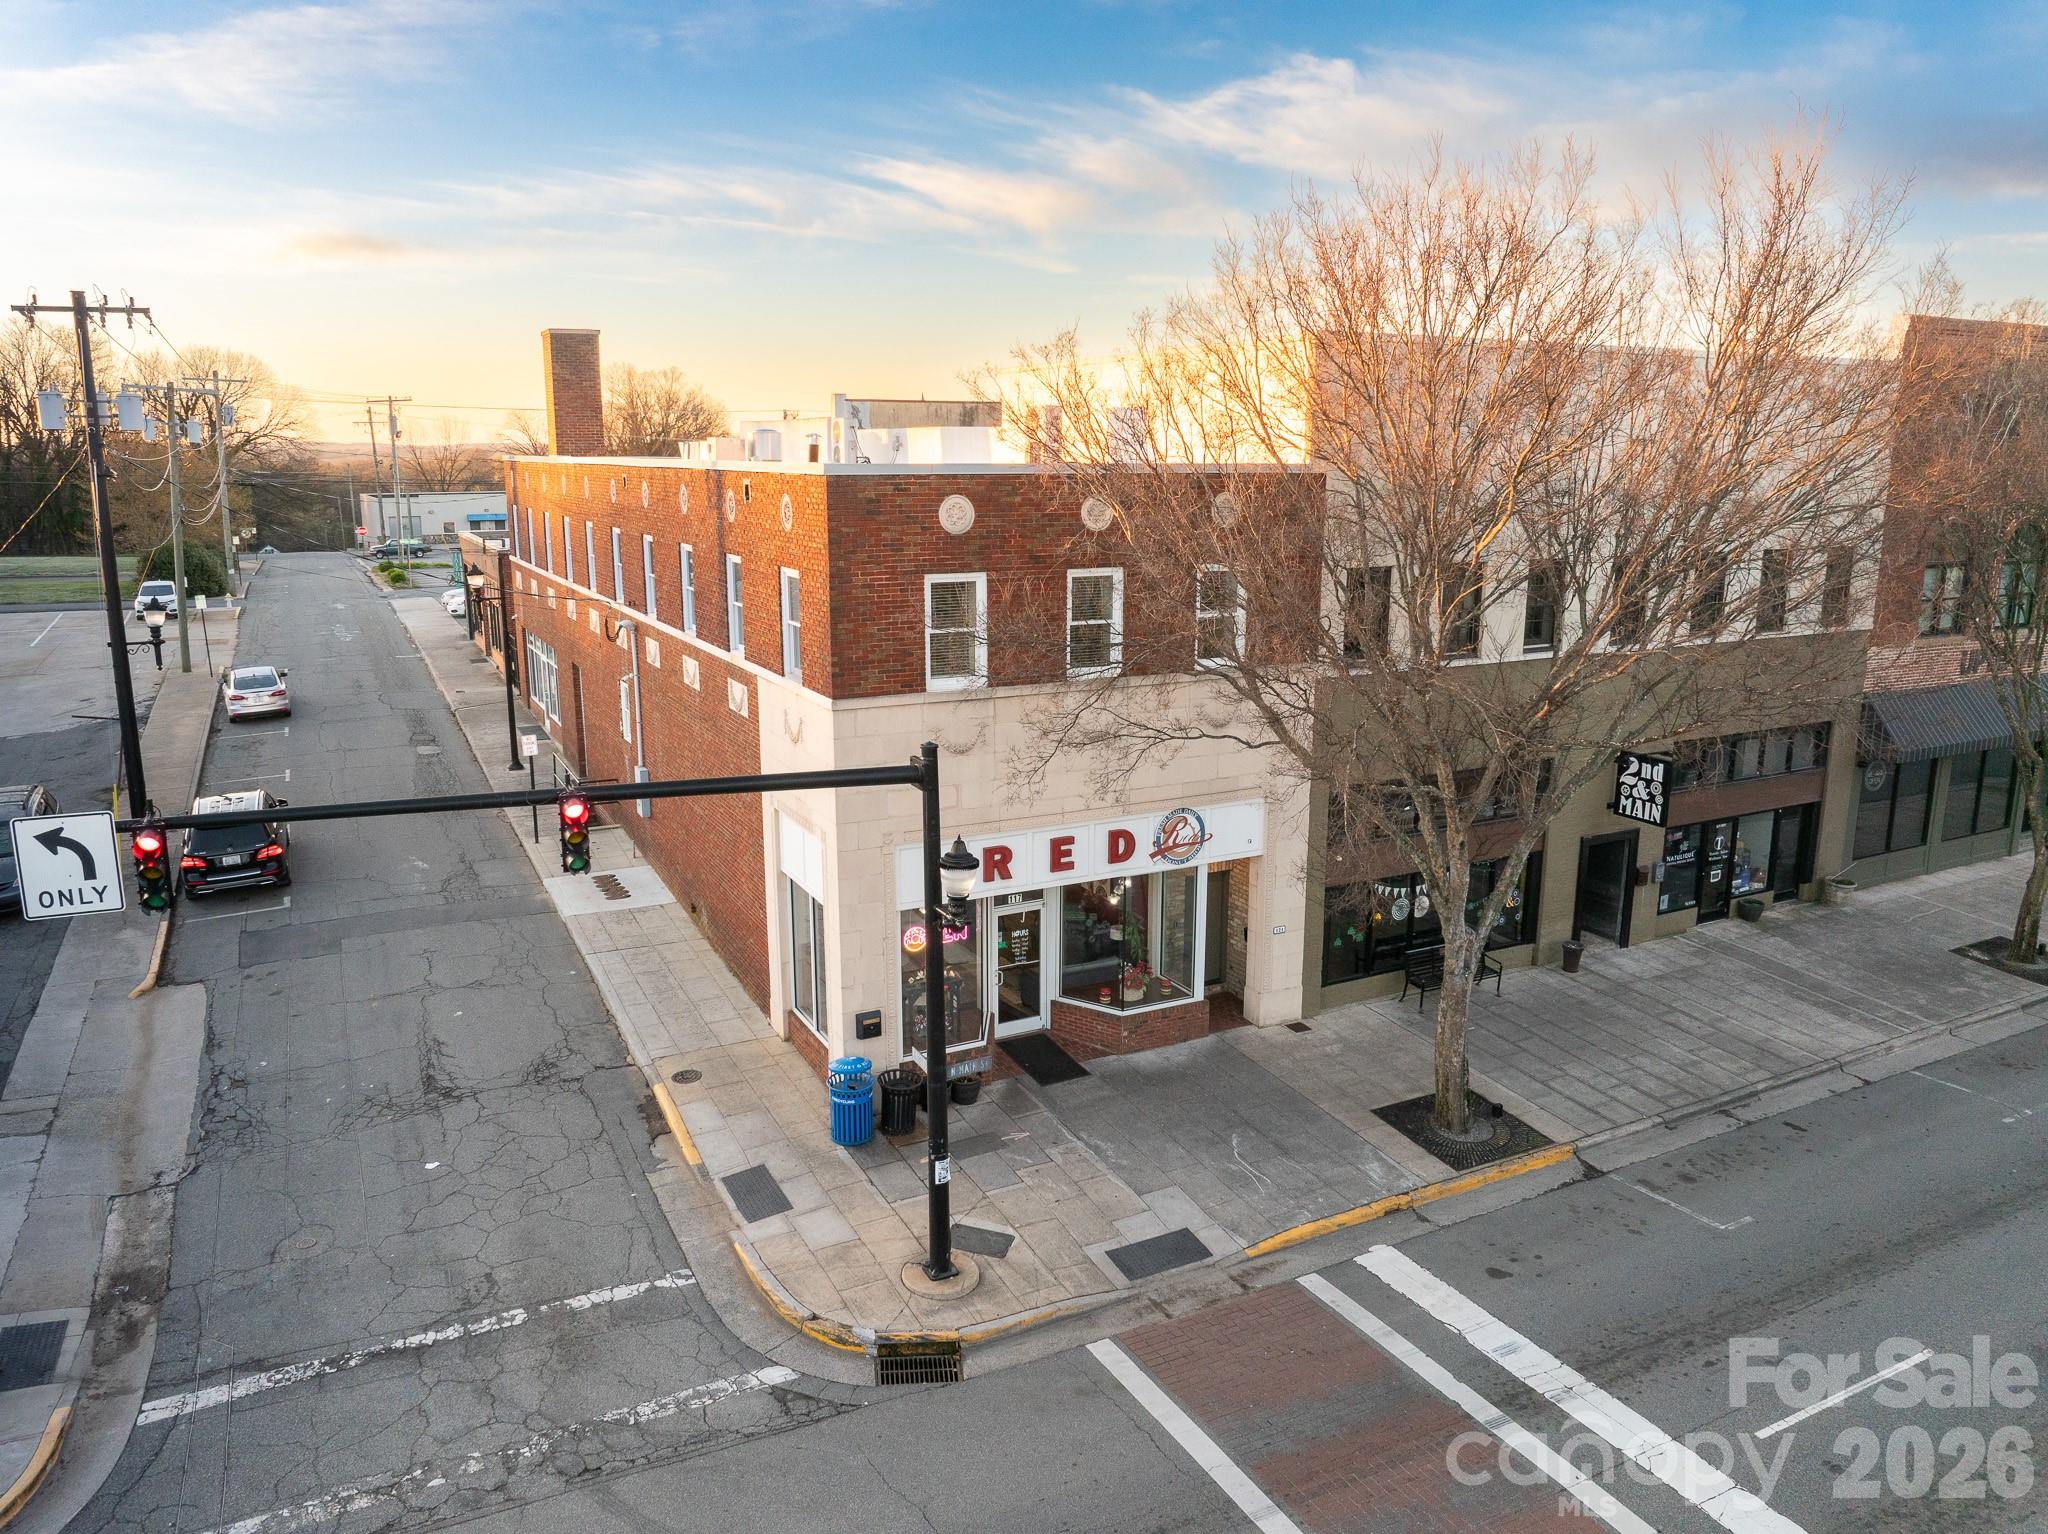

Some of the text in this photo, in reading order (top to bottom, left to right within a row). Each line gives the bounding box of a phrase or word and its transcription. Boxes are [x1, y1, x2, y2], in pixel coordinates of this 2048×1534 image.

[1620, 757, 1664, 786] 2nd
[1632, 780, 1651, 800] &
[1619, 795, 1661, 824] MAIN
[983, 828, 1136, 883] RED
[1666, 851, 1695, 863] NATULIQUE
[38, 885, 108, 908] ONLY
[1009, 893, 1022, 904] 117
[1011, 929, 1029, 937] HOURS
[951, 1067, 956, 1076] N
[959, 1062, 976, 1075] MAIN
